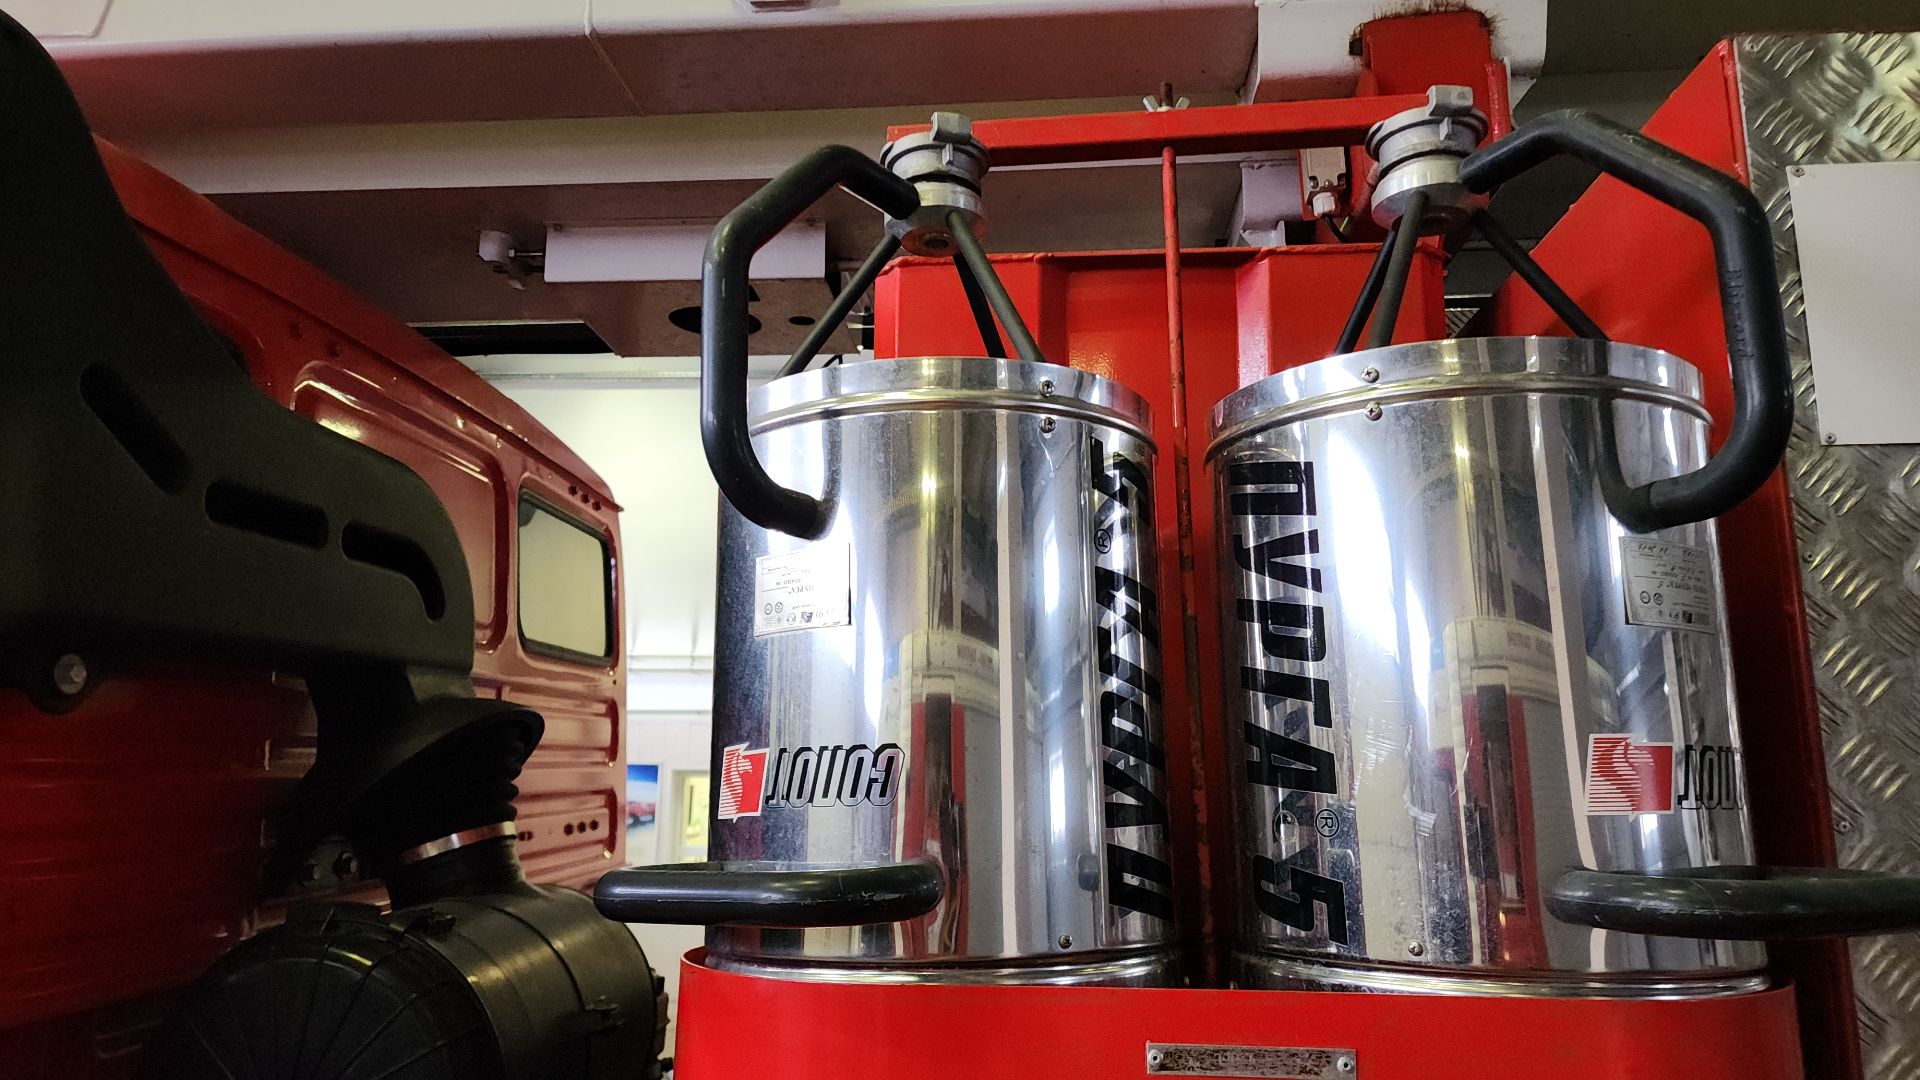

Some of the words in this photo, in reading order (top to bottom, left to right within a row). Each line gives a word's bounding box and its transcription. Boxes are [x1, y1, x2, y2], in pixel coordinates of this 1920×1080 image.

[1090, 435, 1151, 527] 5
[765, 743, 906, 808] СОПОТ
[1253, 854, 1349, 947] 5
